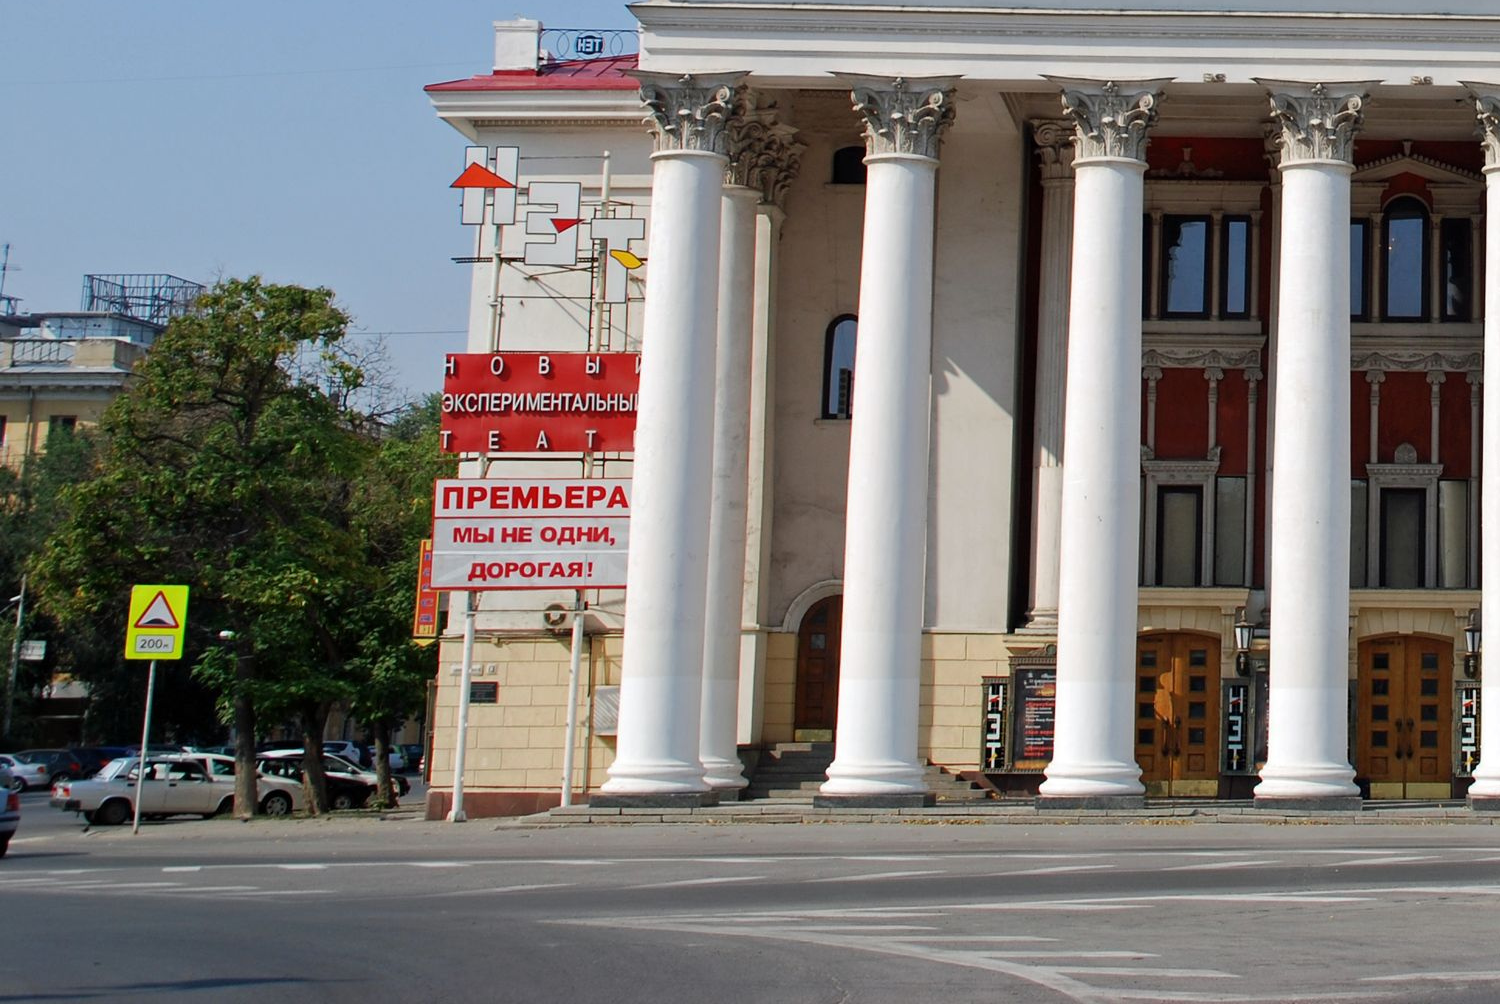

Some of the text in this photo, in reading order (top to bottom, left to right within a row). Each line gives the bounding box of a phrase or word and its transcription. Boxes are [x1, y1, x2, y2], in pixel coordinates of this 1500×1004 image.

[577, 38, 603, 52] НЭТ
[441, 392, 639, 412] ЭКСПЕРИМЕНТАЛЬНЫ
[440, 428, 638, 449] ТЕАТ
[442, 486, 629, 510] ПРЕМЬЕРА
[453, 526, 616, 546] МЫ НЕ ОДНИ,
